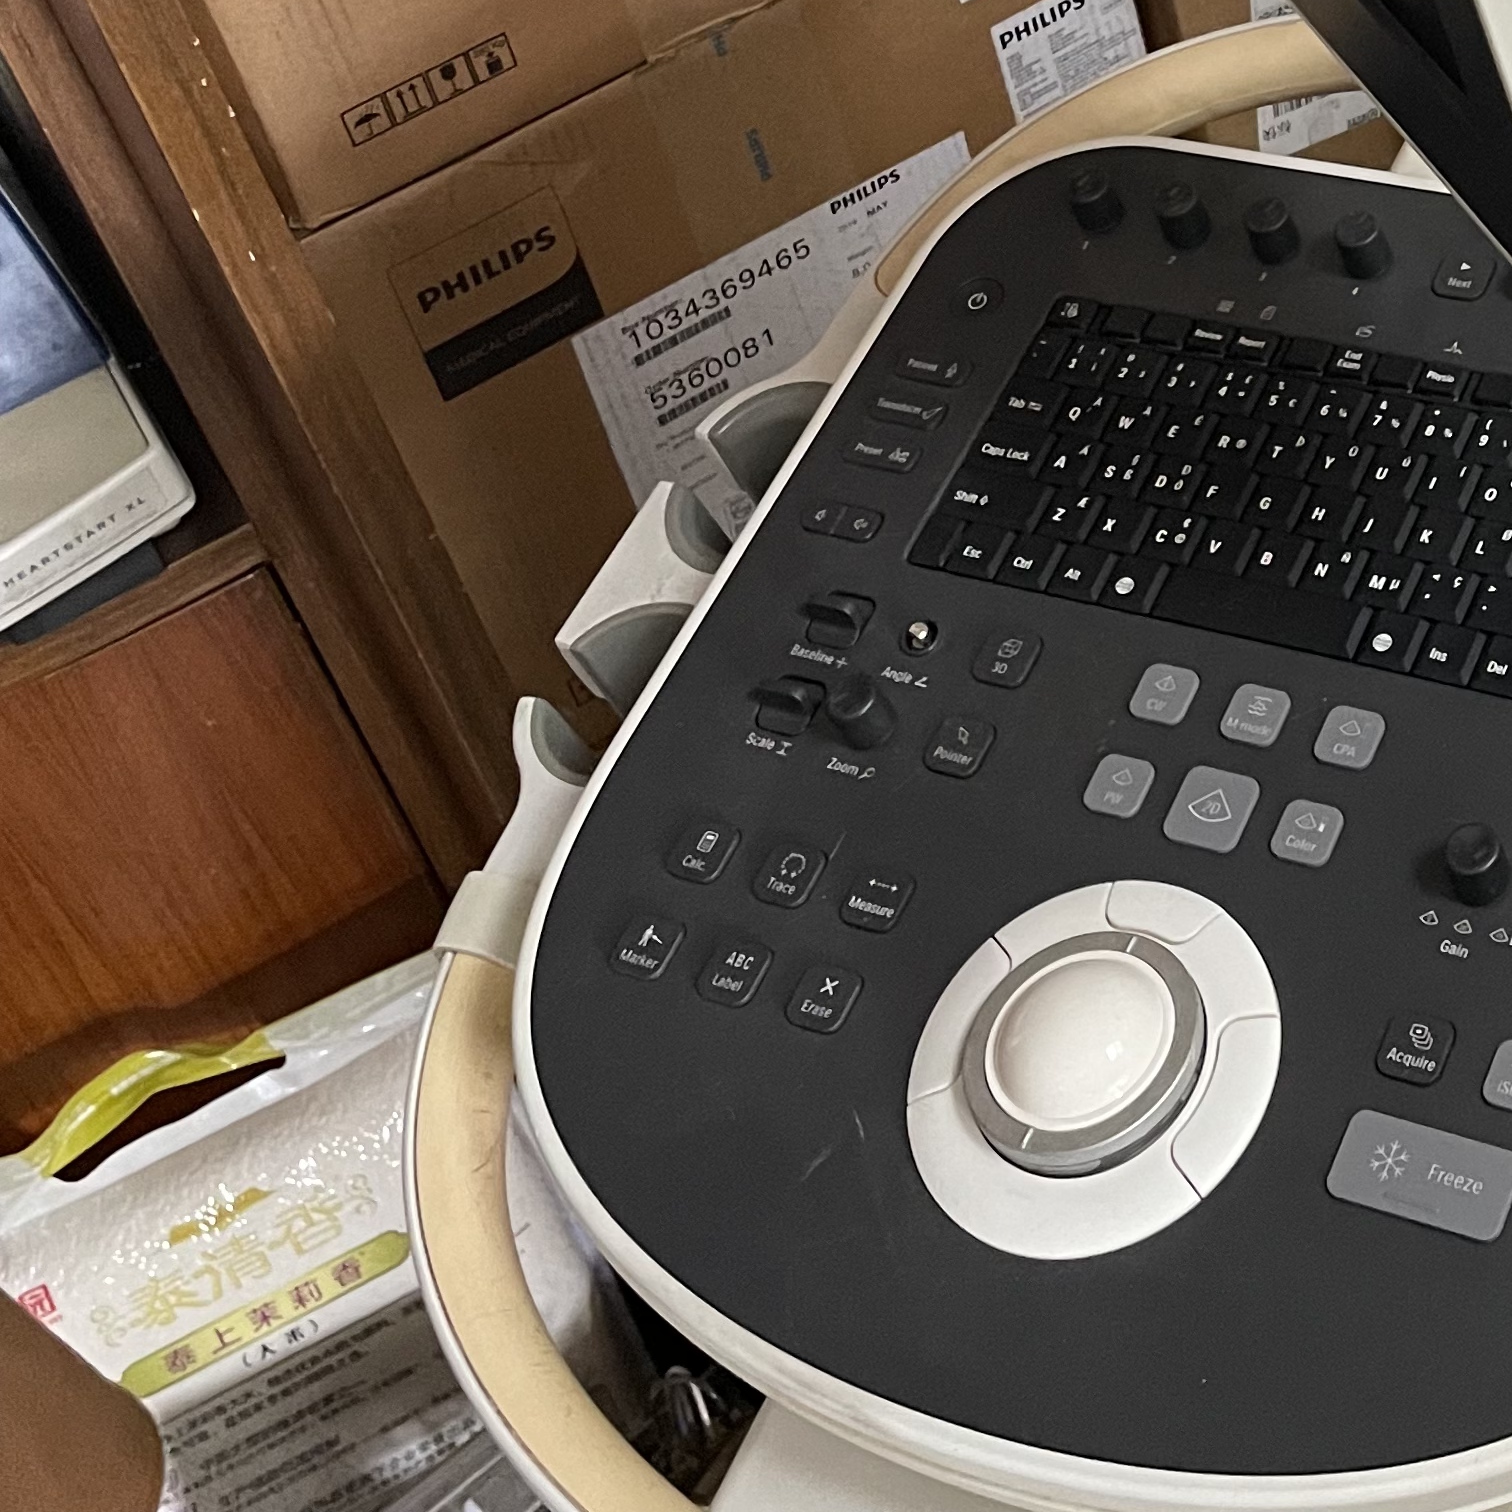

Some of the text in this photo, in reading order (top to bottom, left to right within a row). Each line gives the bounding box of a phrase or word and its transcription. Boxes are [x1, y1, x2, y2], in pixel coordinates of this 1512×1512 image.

[829, 168, 902, 215] PHILIPS
[416, 225, 557, 314] PHILIPS
[1448, 277, 1471, 288] Next
[626, 237, 811, 350] 1034369465
[649, 328, 776, 411] 5360081
[1069, 407, 1081, 421] Q
[1119, 416, 1134, 429] W
[1168, 425, 1179, 437] E
[1218, 436, 1230, 448] R
[1273, 446, 1282, 458] T
[1054, 456, 1066, 468] A
[1325, 456, 1335, 468] Y
[1105, 466, 1116, 477] S
[1376, 467, 1388, 479] U
[1155, 475, 1167, 487] D
[1429, 477, 1437, 489] I
[1207, 486, 1218, 497] F
[1485, 488, 1497, 501] O
[1260, 497, 1271, 509] G
[1053, 508, 1065, 521] Z
[1312, 507, 1325, 520] H
[1103, 519, 1116, 531] X
[1364, 519, 1373, 532] J
[1156, 530, 1167, 542] C
[1420, 530, 1432, 543] K
[2, 511, 118, 589] HEARTSTART
[963, 546, 982, 558] Esc
[1210, 540, 1221, 553] V
[1475, 541, 1483, 554] L
[1260, 552, 1273, 565] B
[1314, 563, 1328, 577] N
[1369, 575, 1386, 589] M
[790, 644, 834, 664] Baseline
[1429, 648, 1447, 661] Ins
[881, 667, 912, 683] Angle
[992, 662, 1008, 674] 3D
[1487, 661, 1508, 675] Del
[746, 732, 775, 750] Scale
[1333, 743, 1355, 757] CPA
[934, 746, 975, 769] Pointer
[827, 757, 859, 775] Zoom
[1201, 799, 1221, 814] 2D
[1285, 835, 1316, 851] Color
[682, 855, 705, 871] Calc
[768, 875, 796, 894] Trace
[849, 896, 894, 918] Measure
[1440, 940, 1468, 958] Gain
[620, 949, 661, 973] Marker
[726, 952, 754, 970] ABC
[712, 974, 743, 991] Label
[801, 999, 832, 1017] Erase
[1387, 1045, 1435, 1071] Acquire
[1428, 1164, 1482, 1194] Freeze
[130, 1190, 347, 1330] 泰清香
